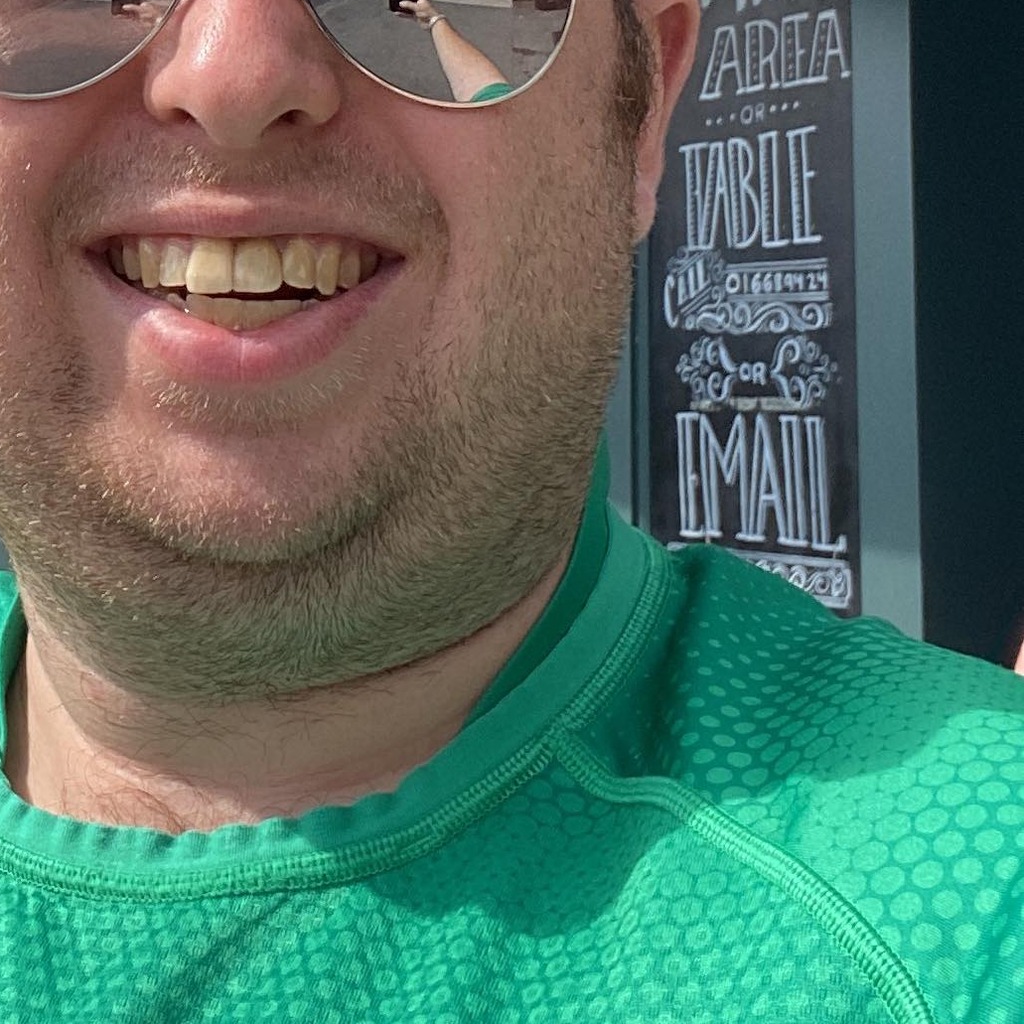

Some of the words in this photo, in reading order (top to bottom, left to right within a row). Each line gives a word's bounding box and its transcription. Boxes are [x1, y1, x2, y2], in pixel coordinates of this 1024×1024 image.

[699, 9, 851, 100] AREA
[679, 125, 824, 251] TABLE
[739, 362, 767, 385] OR
[675, 412, 848, 552] EMAIL
